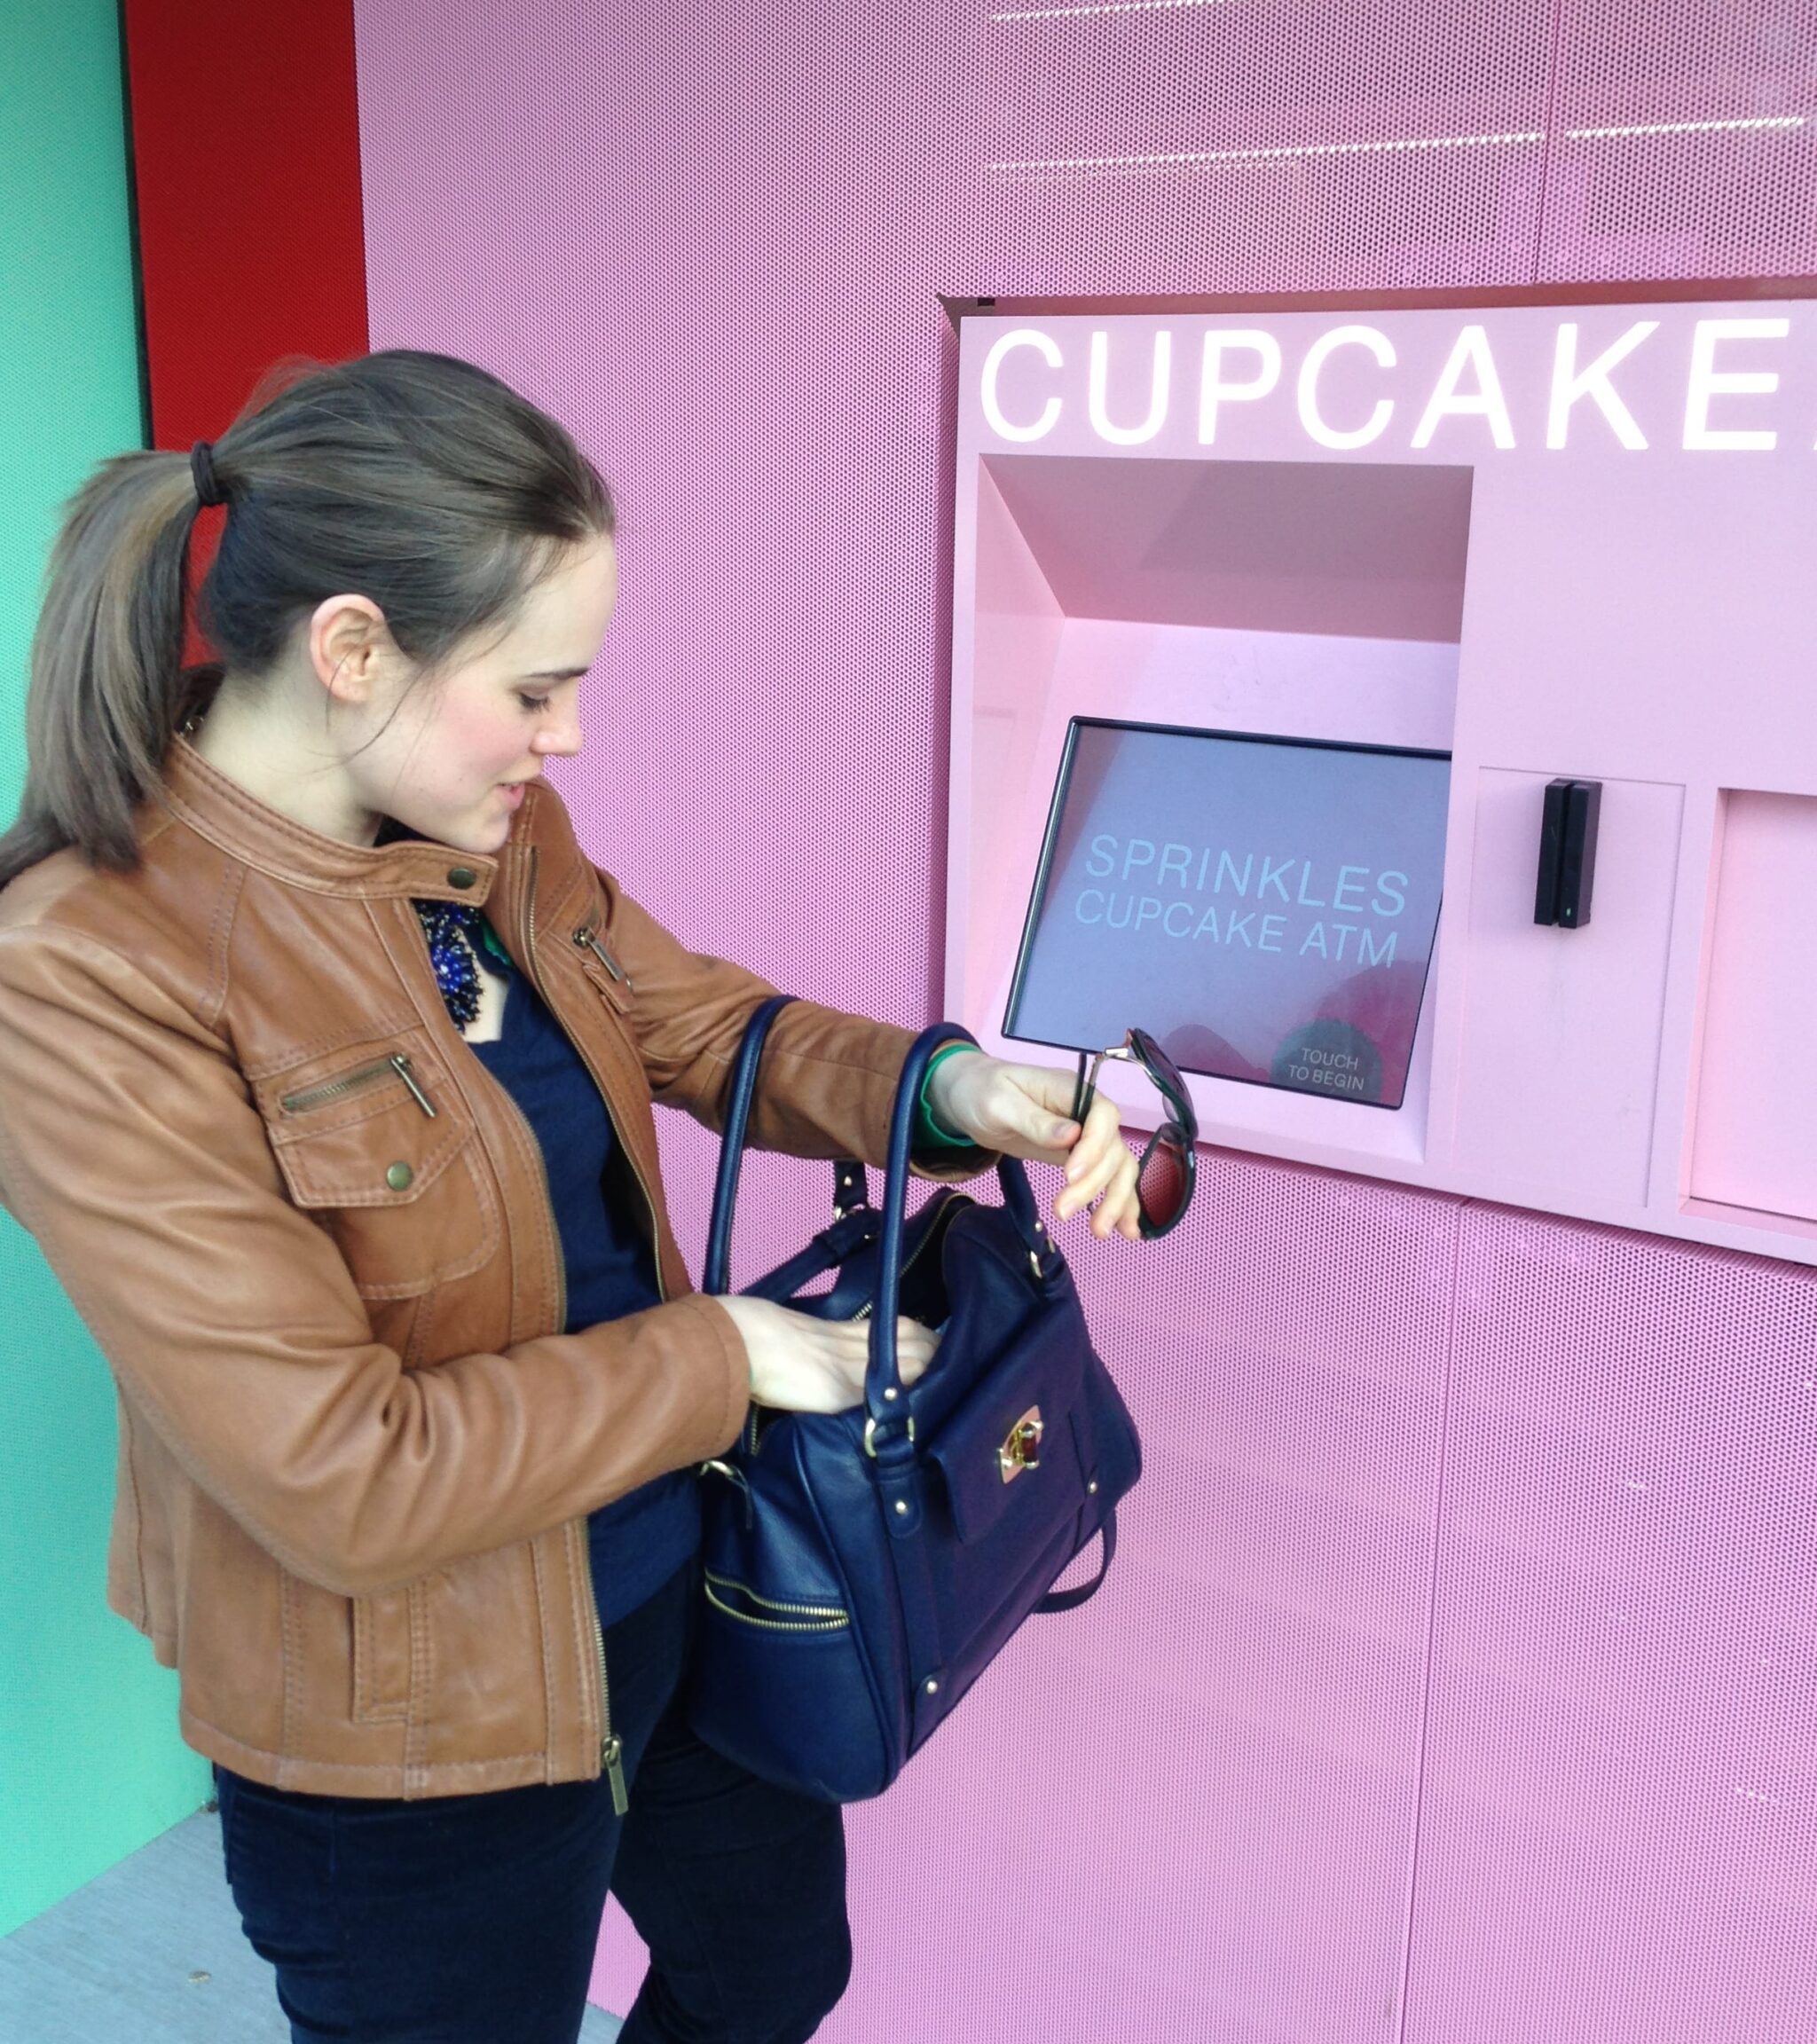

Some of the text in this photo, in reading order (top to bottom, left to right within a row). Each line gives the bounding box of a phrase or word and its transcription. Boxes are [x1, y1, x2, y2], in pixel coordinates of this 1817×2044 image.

[979, 318, 1789, 451] CUPCAKE
[1085, 834, 1409, 916] SPRINKLES
[1075, 889, 1399, 969] CUPCAKE ATM
[1289, 1065, 1365, 1091] TO BEGIN
[1302, 1047, 1358, 1071] TOUCH
